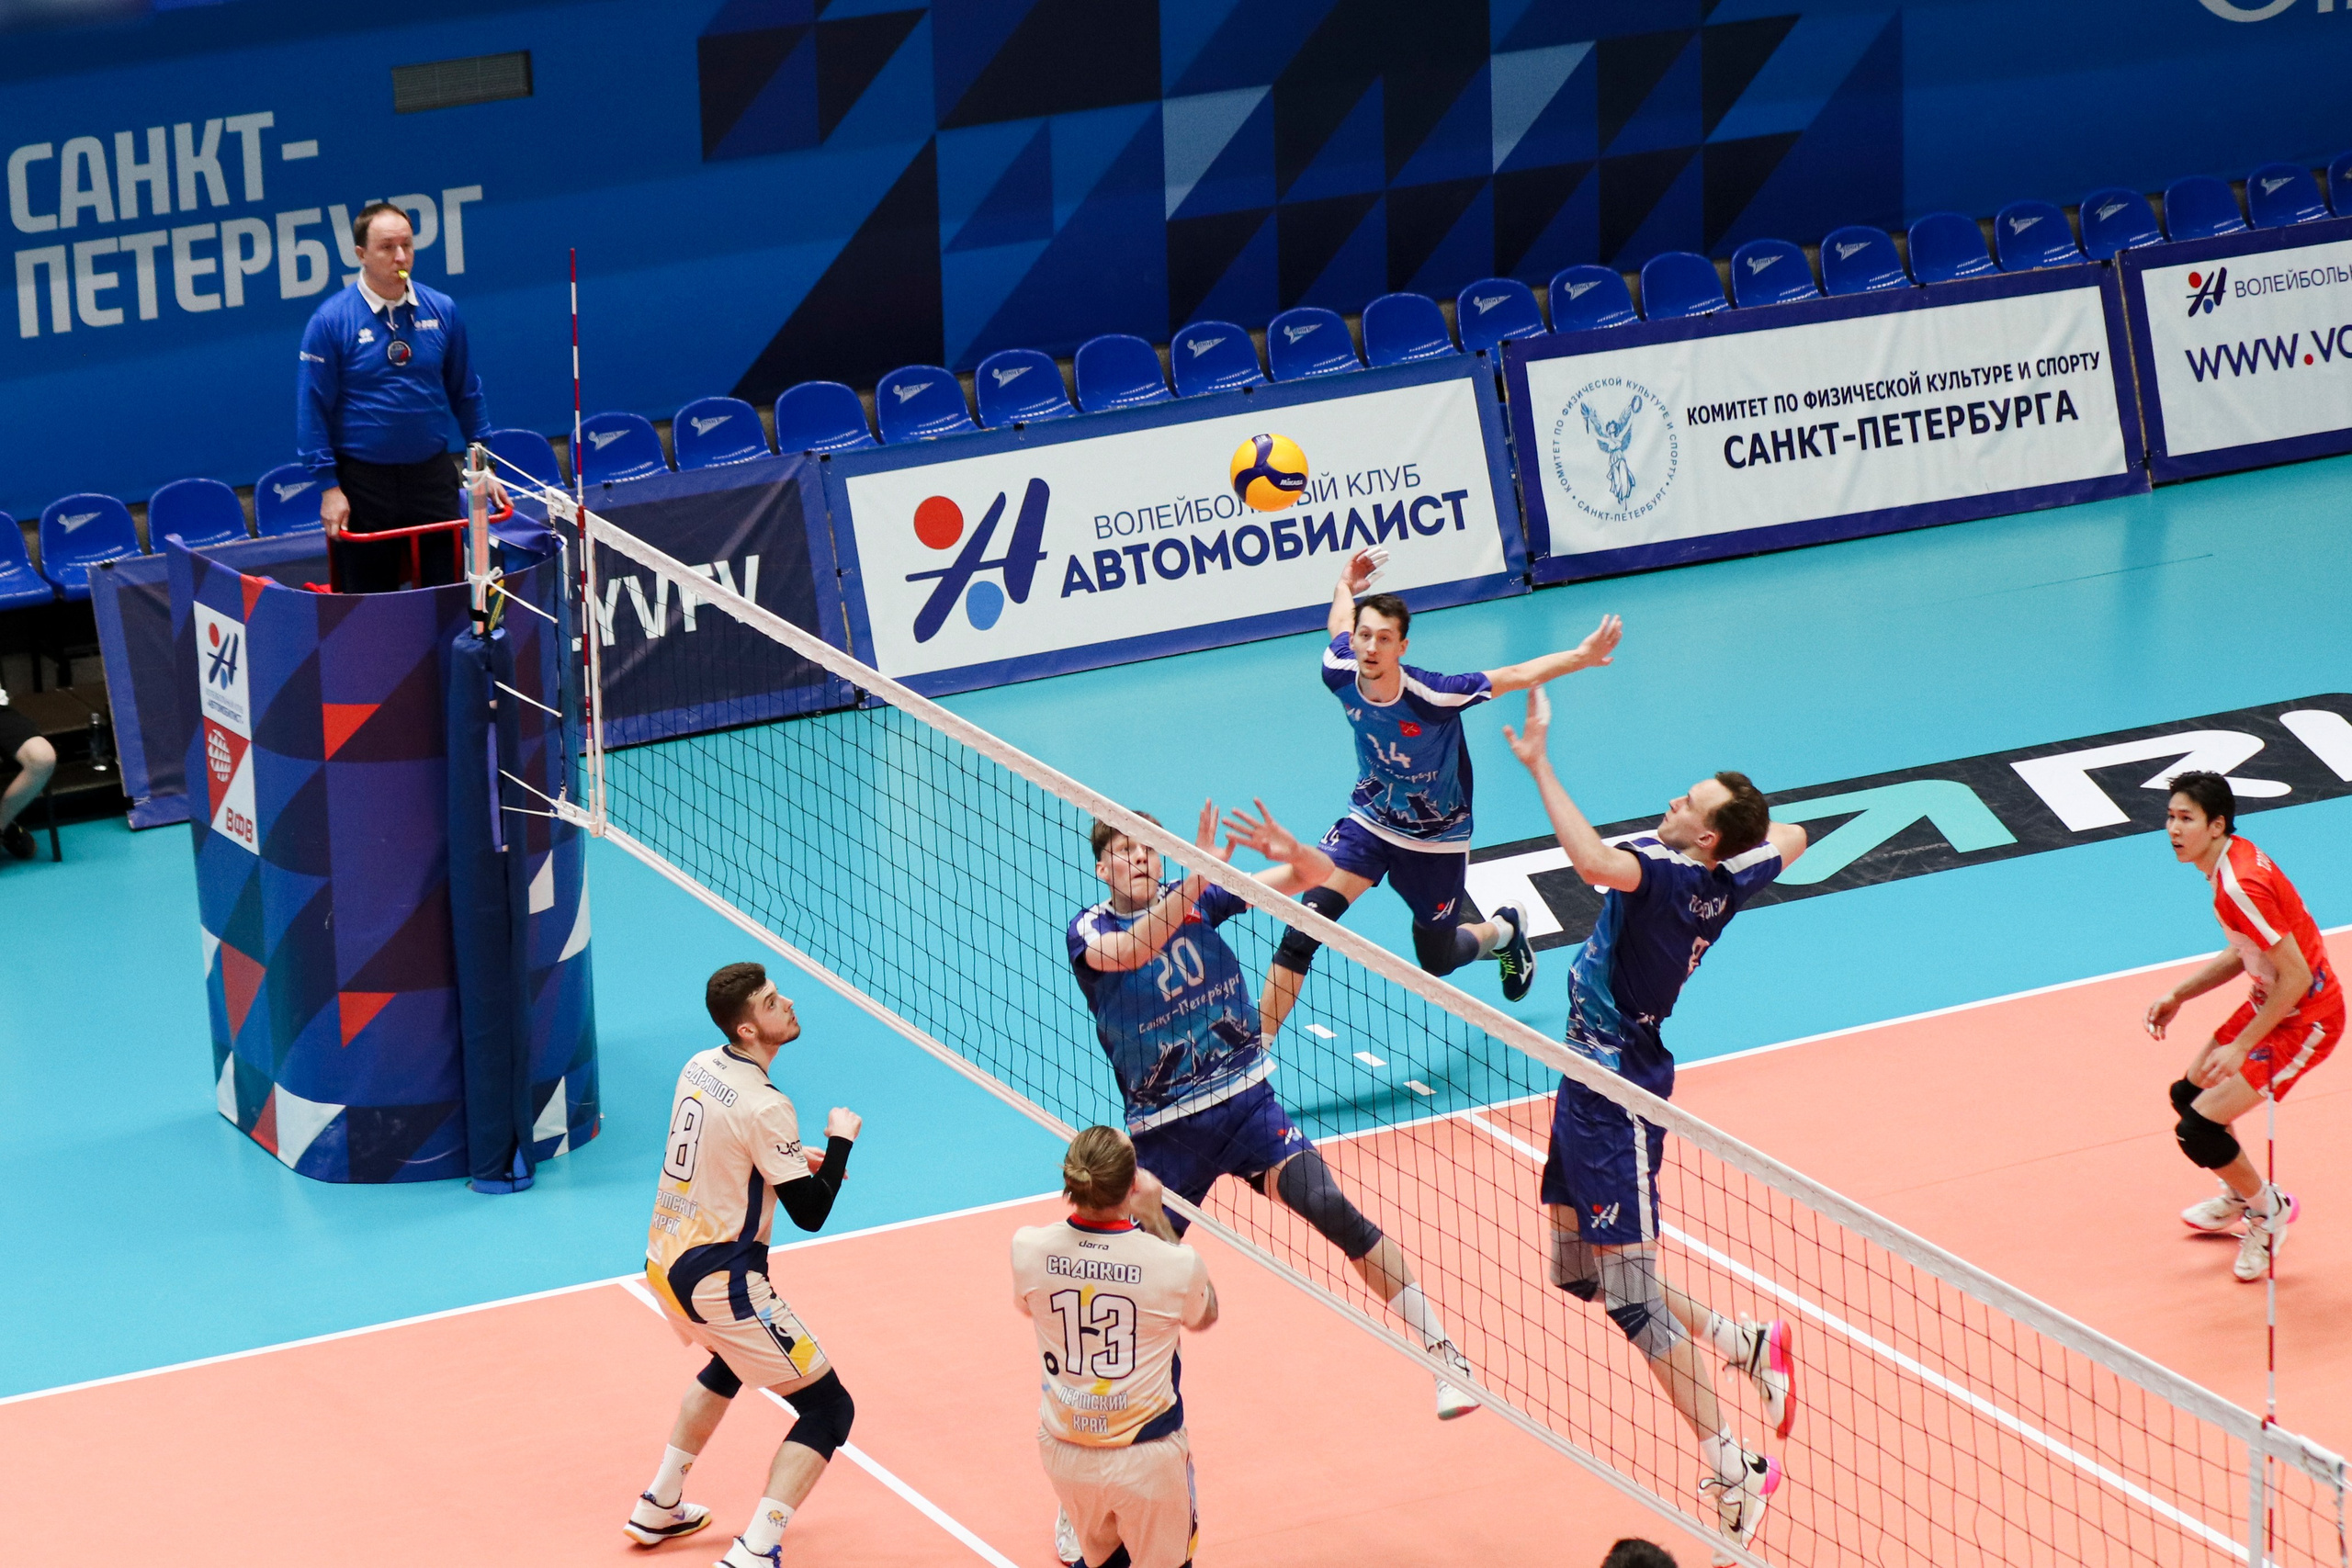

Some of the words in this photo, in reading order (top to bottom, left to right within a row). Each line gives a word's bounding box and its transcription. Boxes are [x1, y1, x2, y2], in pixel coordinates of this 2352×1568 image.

[7, 110, 319, 234] САНКТ-
[2234, 264, 2352, 298] ВОЛЕЙБОЛЬ
[1562, 378, 1623, 416] ФИЗИЧЕСКОЙ
[1626, 379, 1669, 419] КУЛЬТУРЕ
[1687, 397, 1768, 426] КОМИТЕТ
[1774, 393, 1798, 413] ПО
[1804, 370, 1922, 410] ФИЗИЧЕСКОЙ
[1927, 364, 2014, 393] КУЛЬТУРЕ
[2018, 361, 2031, 380] И
[2036, 351, 2100, 378] СПОРТУ
[1555, 419, 1564, 435] ПО
[1666, 422, 1675, 430] И
[1724, 389, 2079, 469] САНКТ-ПЕТЕРБУРГА
[1553, 439, 1572, 493] КОМИТЕТ
[1668, 434, 1679, 481] СПОРТУ
[1093, 472, 1339, 540] ВОЛЕЙБОЫЙ
[1347, 463, 1421, 499] КЛУБ
[1577, 486, 1668, 523] САНКТ-ПЕТЕРБУРГ
[1060, 489, 1469, 599] АВТОМОБИЛИСТ
[1366, 732, 1412, 769] 14
[225, 806, 254, 844] ВФВ
[1319, 824, 1340, 846] 14
[1149, 936, 1205, 1002] 20
[1138, 972, 1240, 1035] Санкт-Петербург
[662, 1096, 704, 1183] 8
[652, 1212, 682, 1237] КРАЙ
[1079, 1239, 1109, 1251] darra
[1046, 1255, 1142, 1284] САДАКОВ
[1049, 1288, 1136, 1380] 13
[1057, 1385, 1129, 1411] ПЕРМСКИЙ
[1072, 1415, 1109, 1435] КРАЙ
